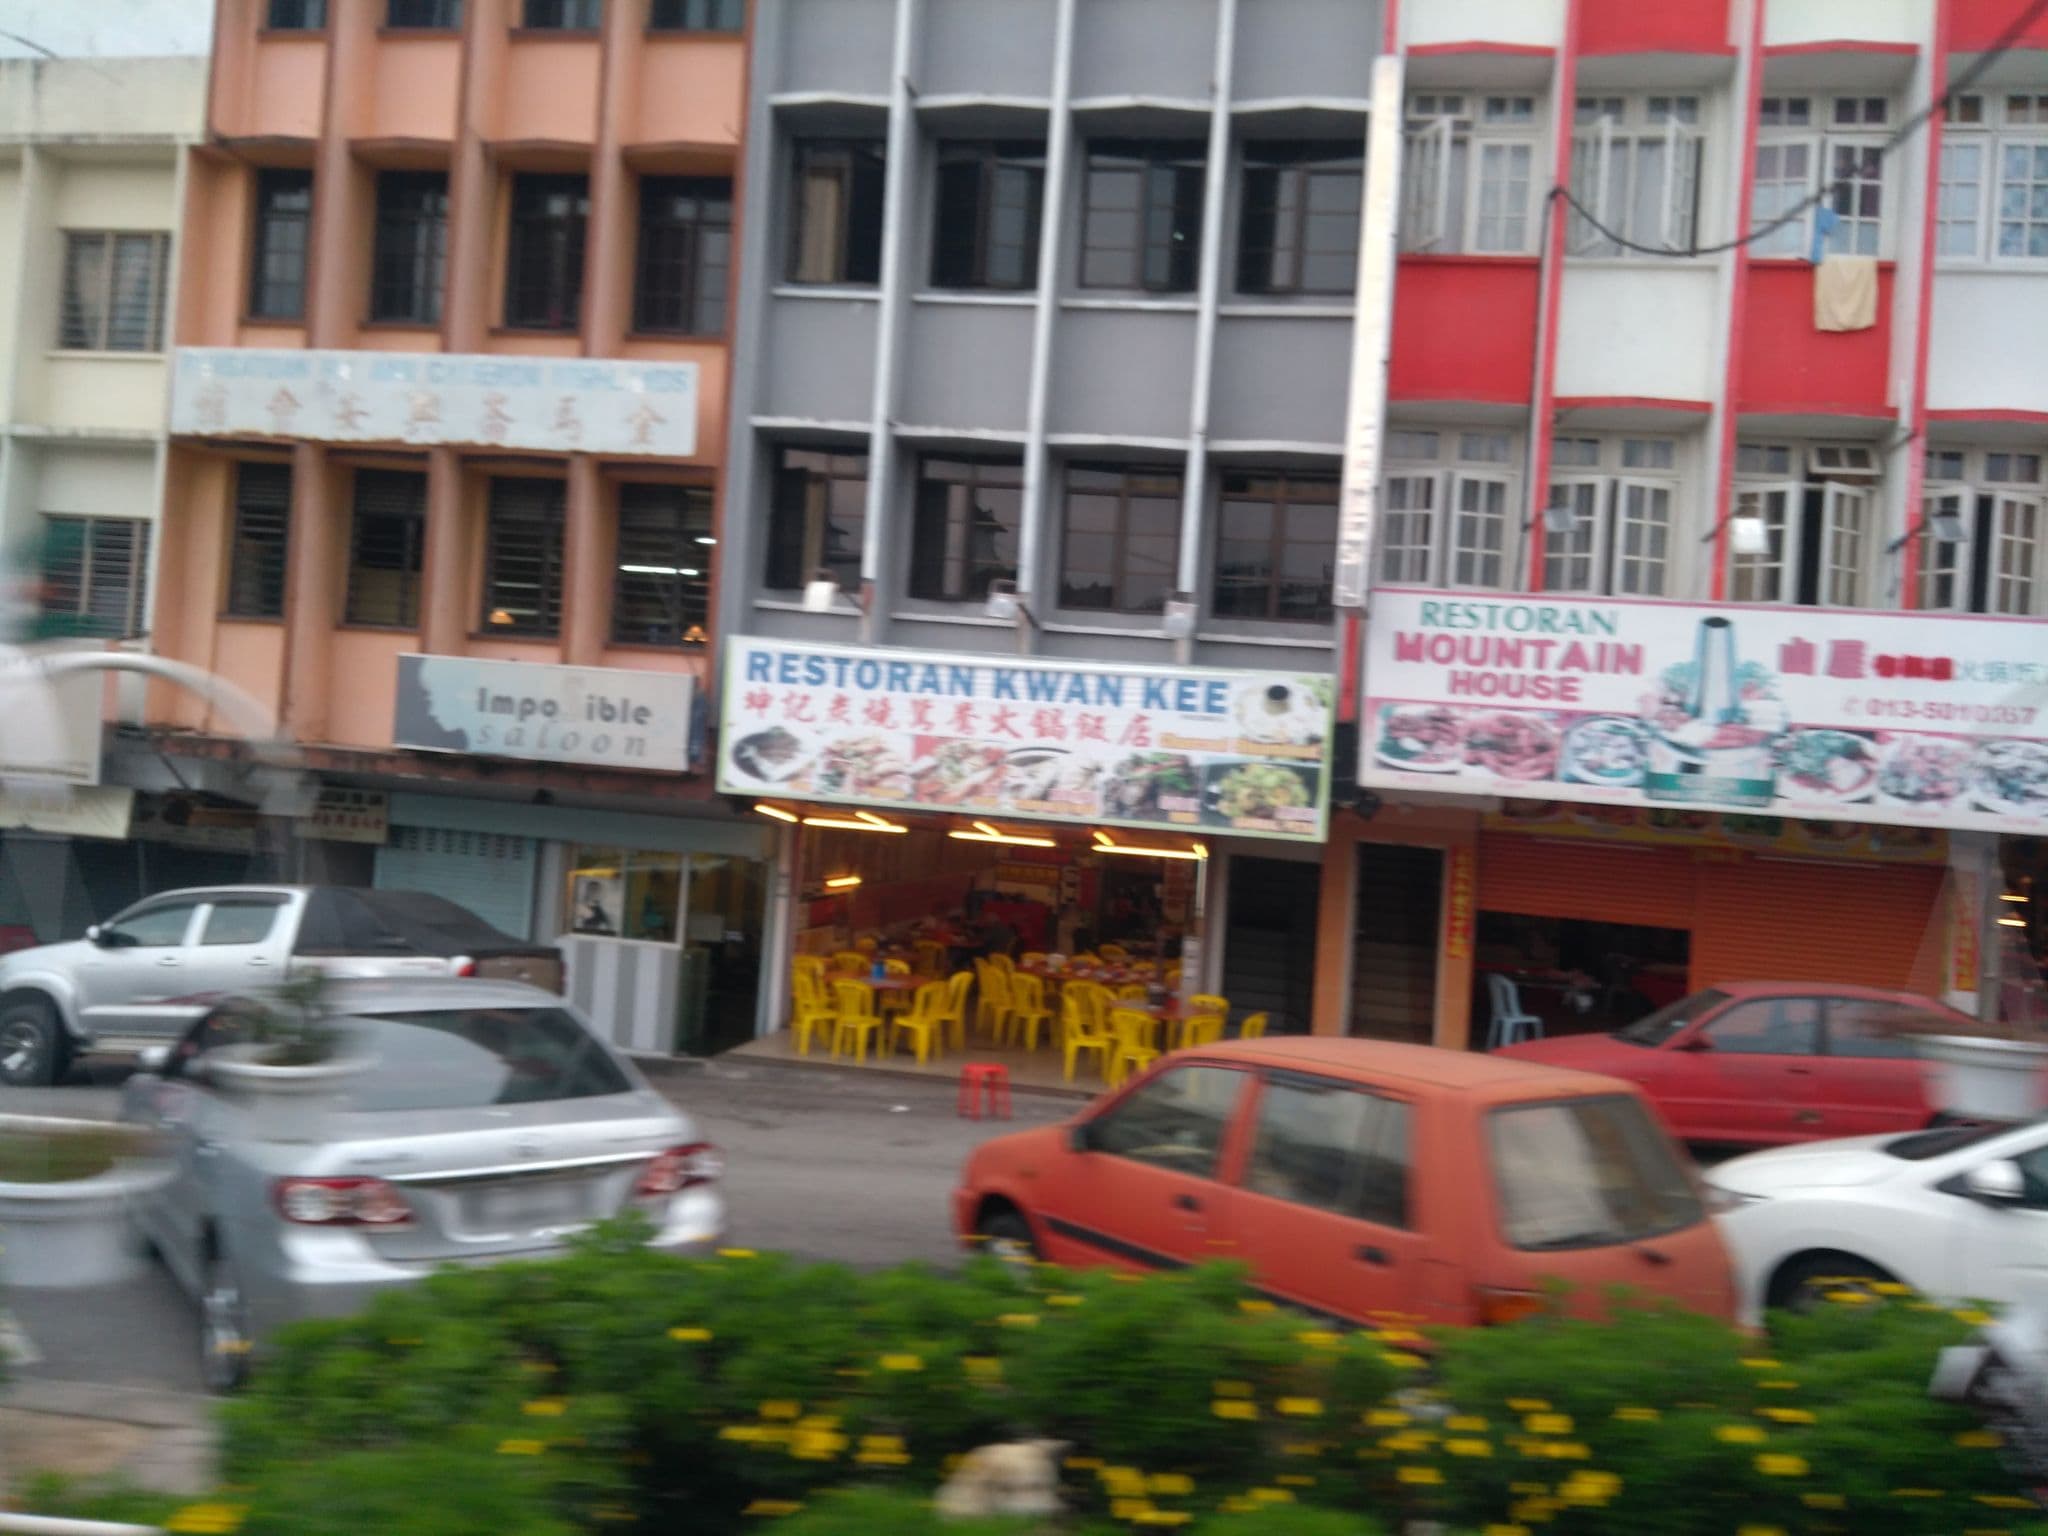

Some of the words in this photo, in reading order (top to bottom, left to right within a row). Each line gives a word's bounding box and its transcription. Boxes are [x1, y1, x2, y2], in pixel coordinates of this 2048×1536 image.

[1420, 601, 1617, 635] RESTORAN
[1393, 631, 1645, 675] MOUNTAIN
[747, 651, 974, 697] RESTORAN
[993, 667, 1121, 708] KWAN
[1143, 678, 1229, 714] KEE
[1448, 669, 1584, 702] HOUSE
[477, 724, 646, 757] saloon
